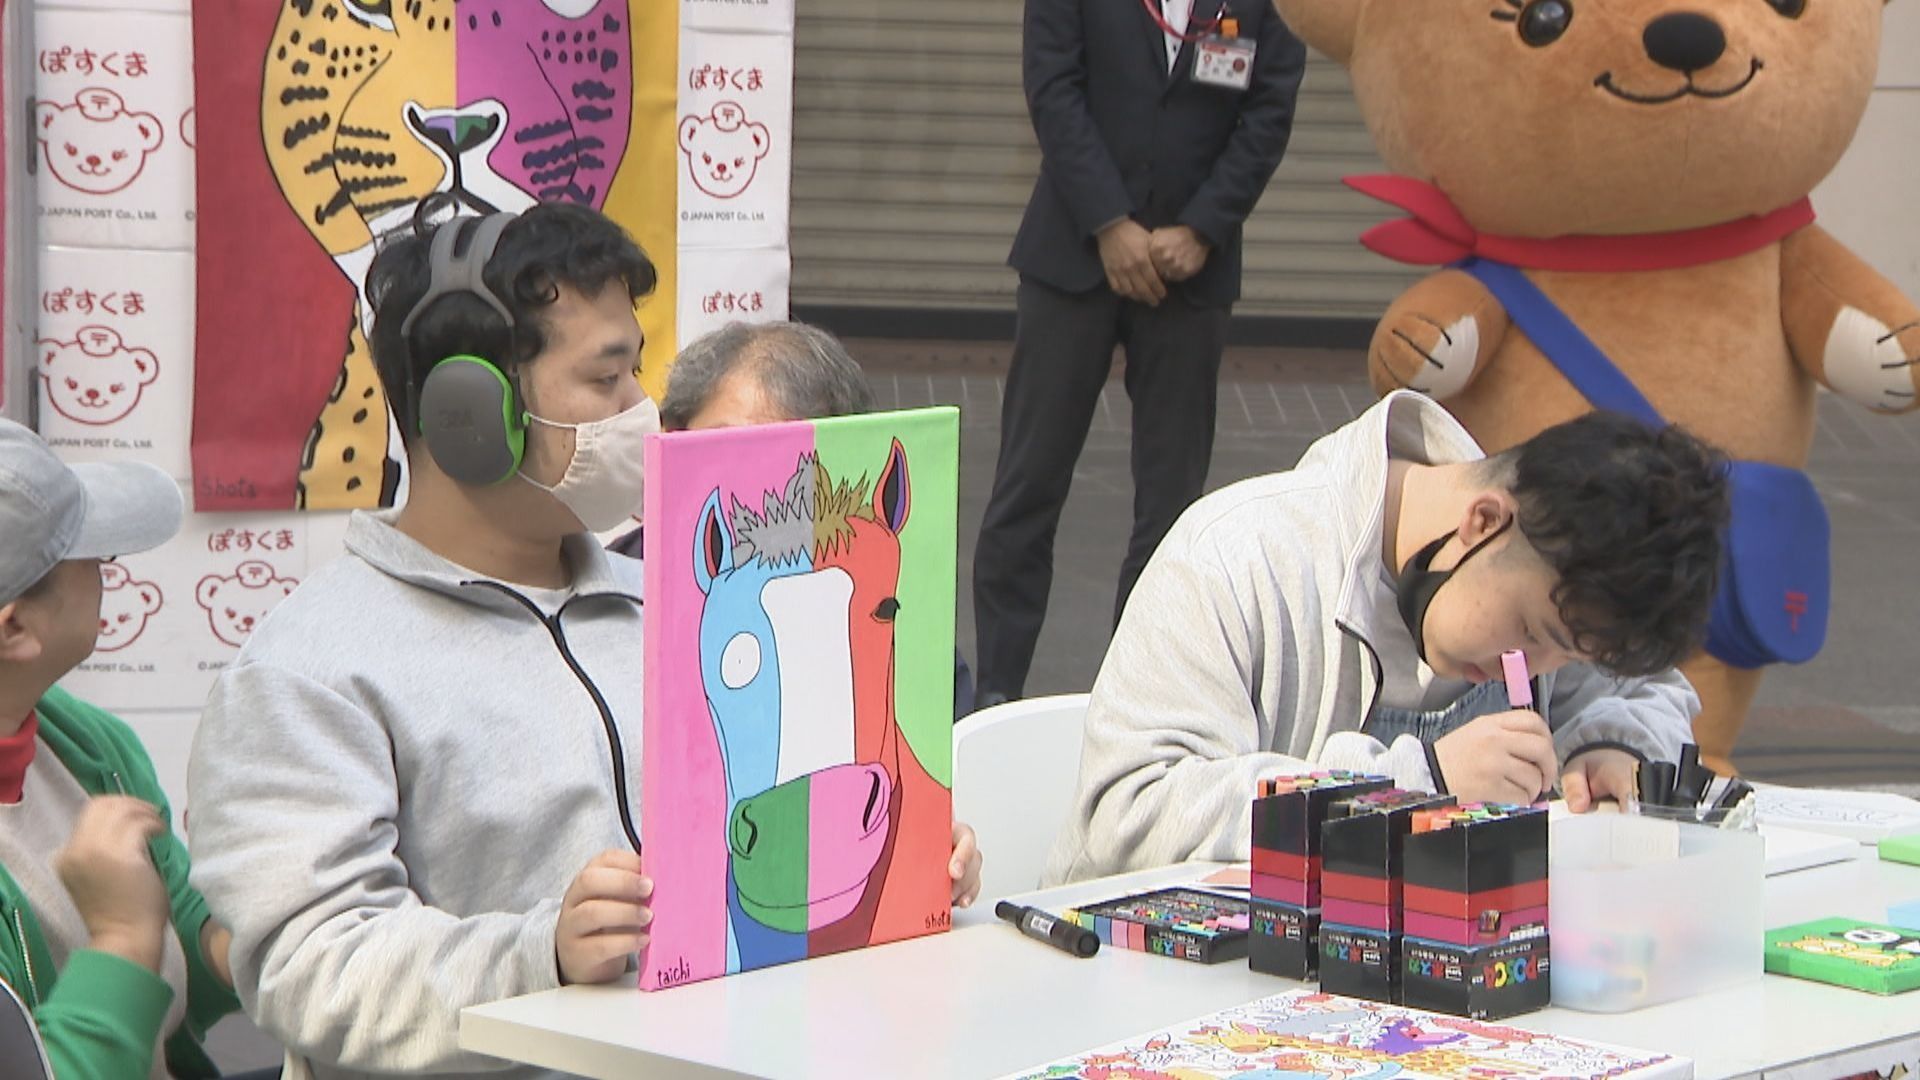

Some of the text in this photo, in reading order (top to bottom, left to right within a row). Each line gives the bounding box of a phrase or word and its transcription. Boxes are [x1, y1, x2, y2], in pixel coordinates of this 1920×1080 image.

[39, 45, 148, 76] ぽすくま
[688, 63, 763, 91] ぽすくま
[85, 208, 112, 218] POST
[715, 211, 735, 221] POST
[43, 287, 145, 315] ぽすくま
[702, 290, 763, 314] ぽすくま
[83, 438, 110, 448] POST
[207, 528, 295, 552] ぽすくま
[657, 955, 691, 987] taichi
[1483, 955, 1538, 989] POSCA
